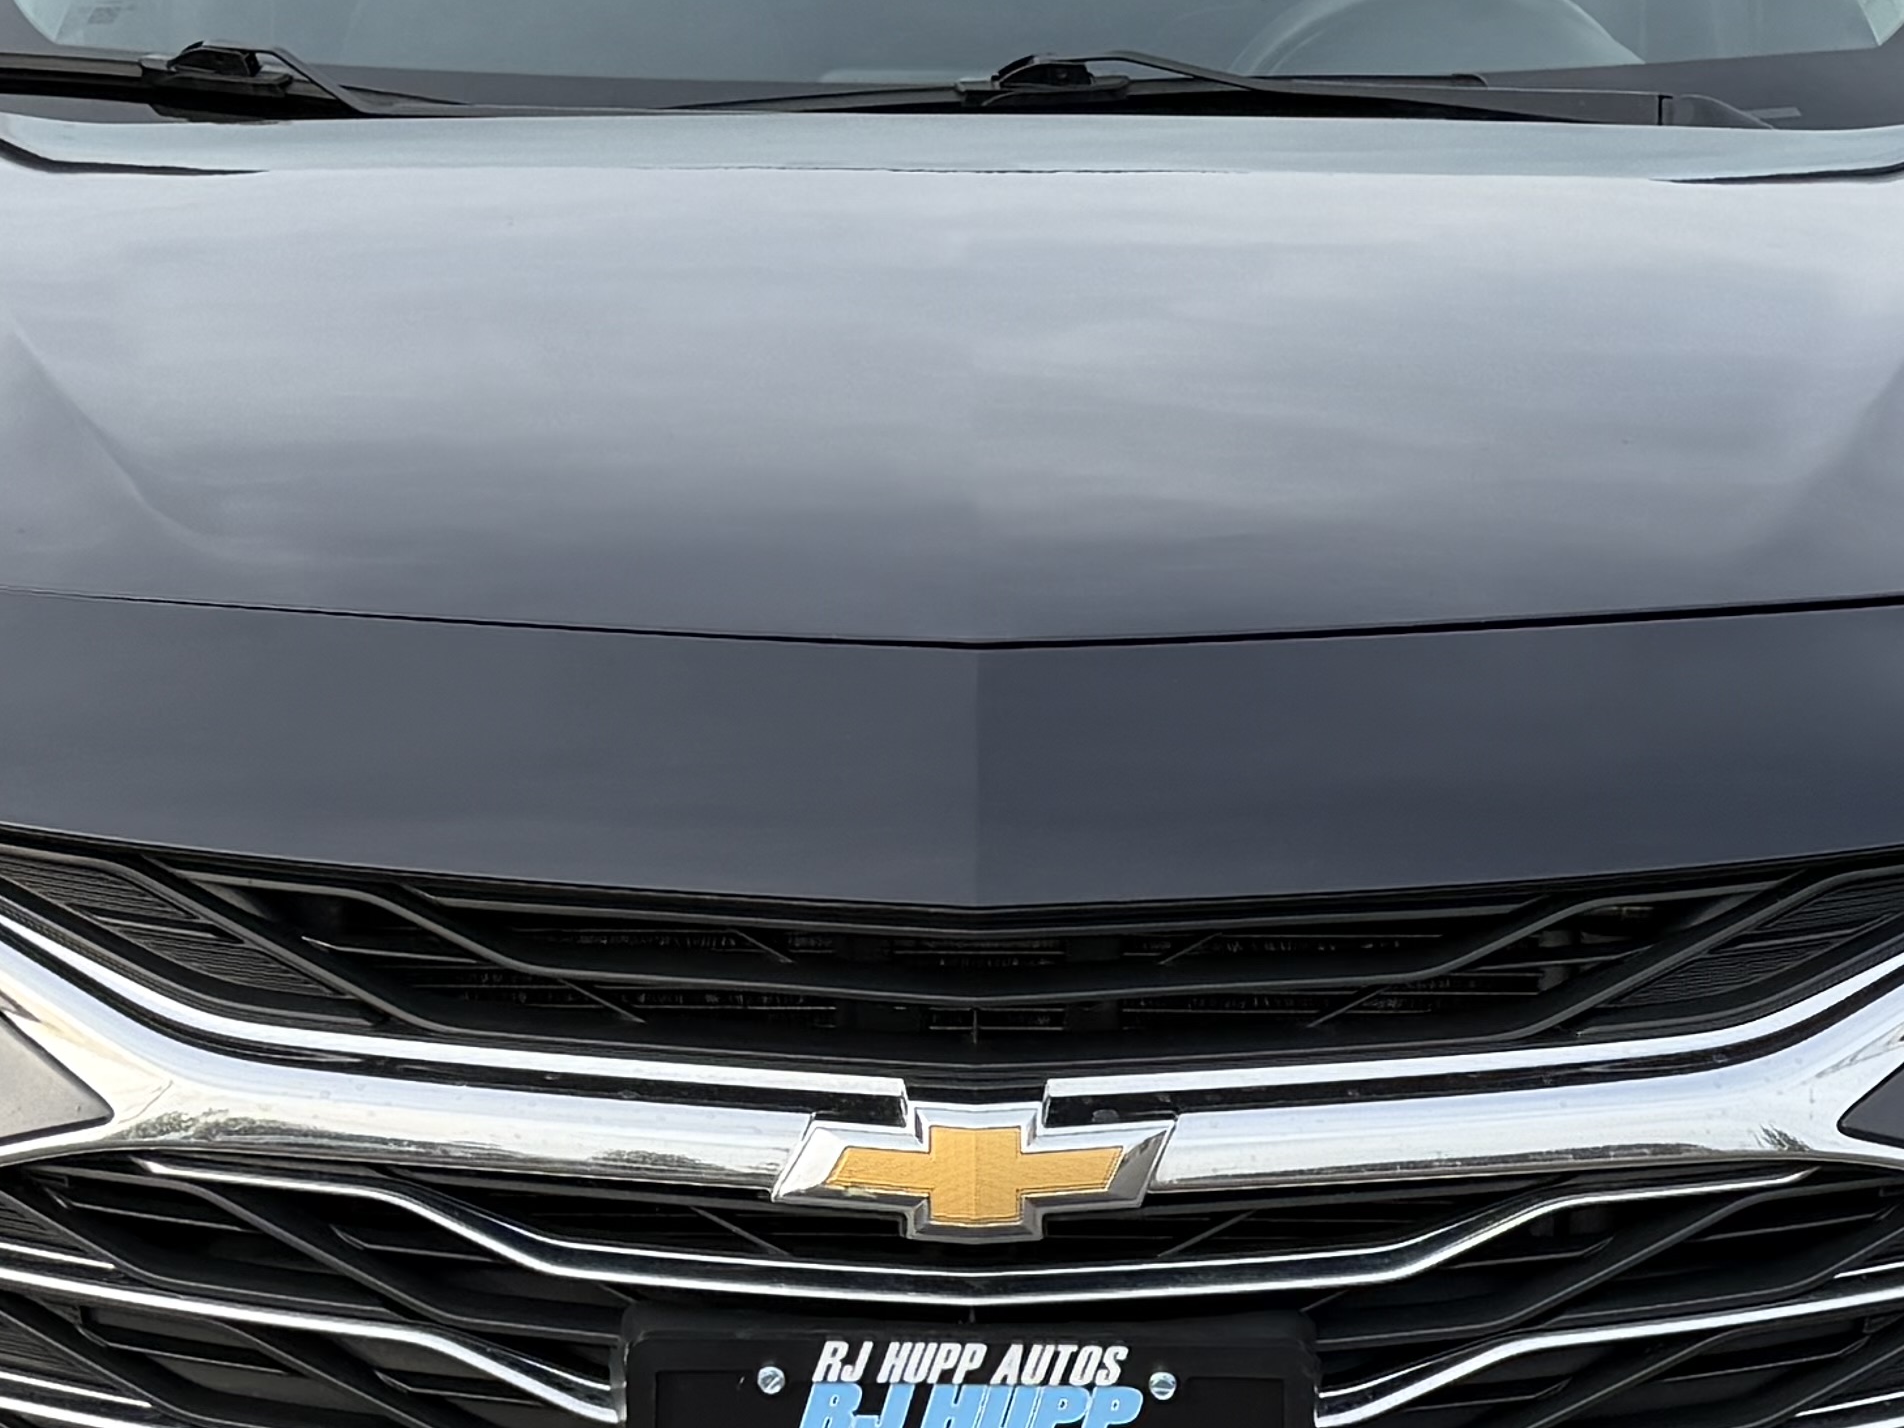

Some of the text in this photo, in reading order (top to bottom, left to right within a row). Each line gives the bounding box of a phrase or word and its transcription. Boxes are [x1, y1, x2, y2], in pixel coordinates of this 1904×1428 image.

[812, 1340, 1130, 1387] RJ HUPP AUTOS
